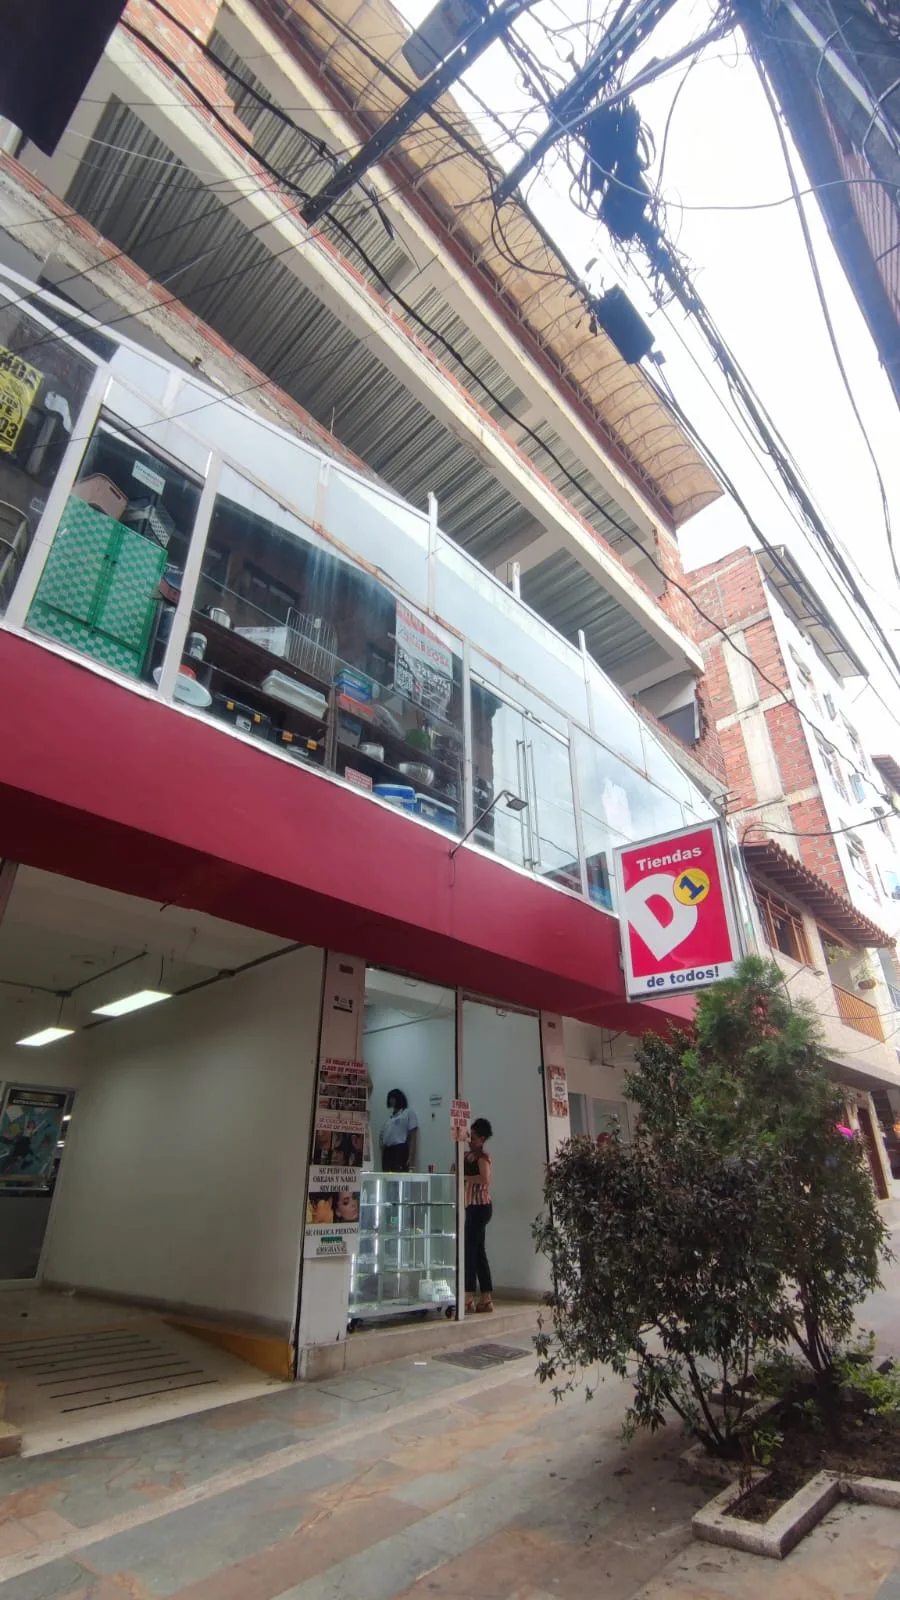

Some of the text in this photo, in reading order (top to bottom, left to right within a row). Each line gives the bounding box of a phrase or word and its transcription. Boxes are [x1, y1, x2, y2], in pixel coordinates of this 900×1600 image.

[636, 847, 702, 872] Tiendas
[647, 966, 720, 988] de todos!
